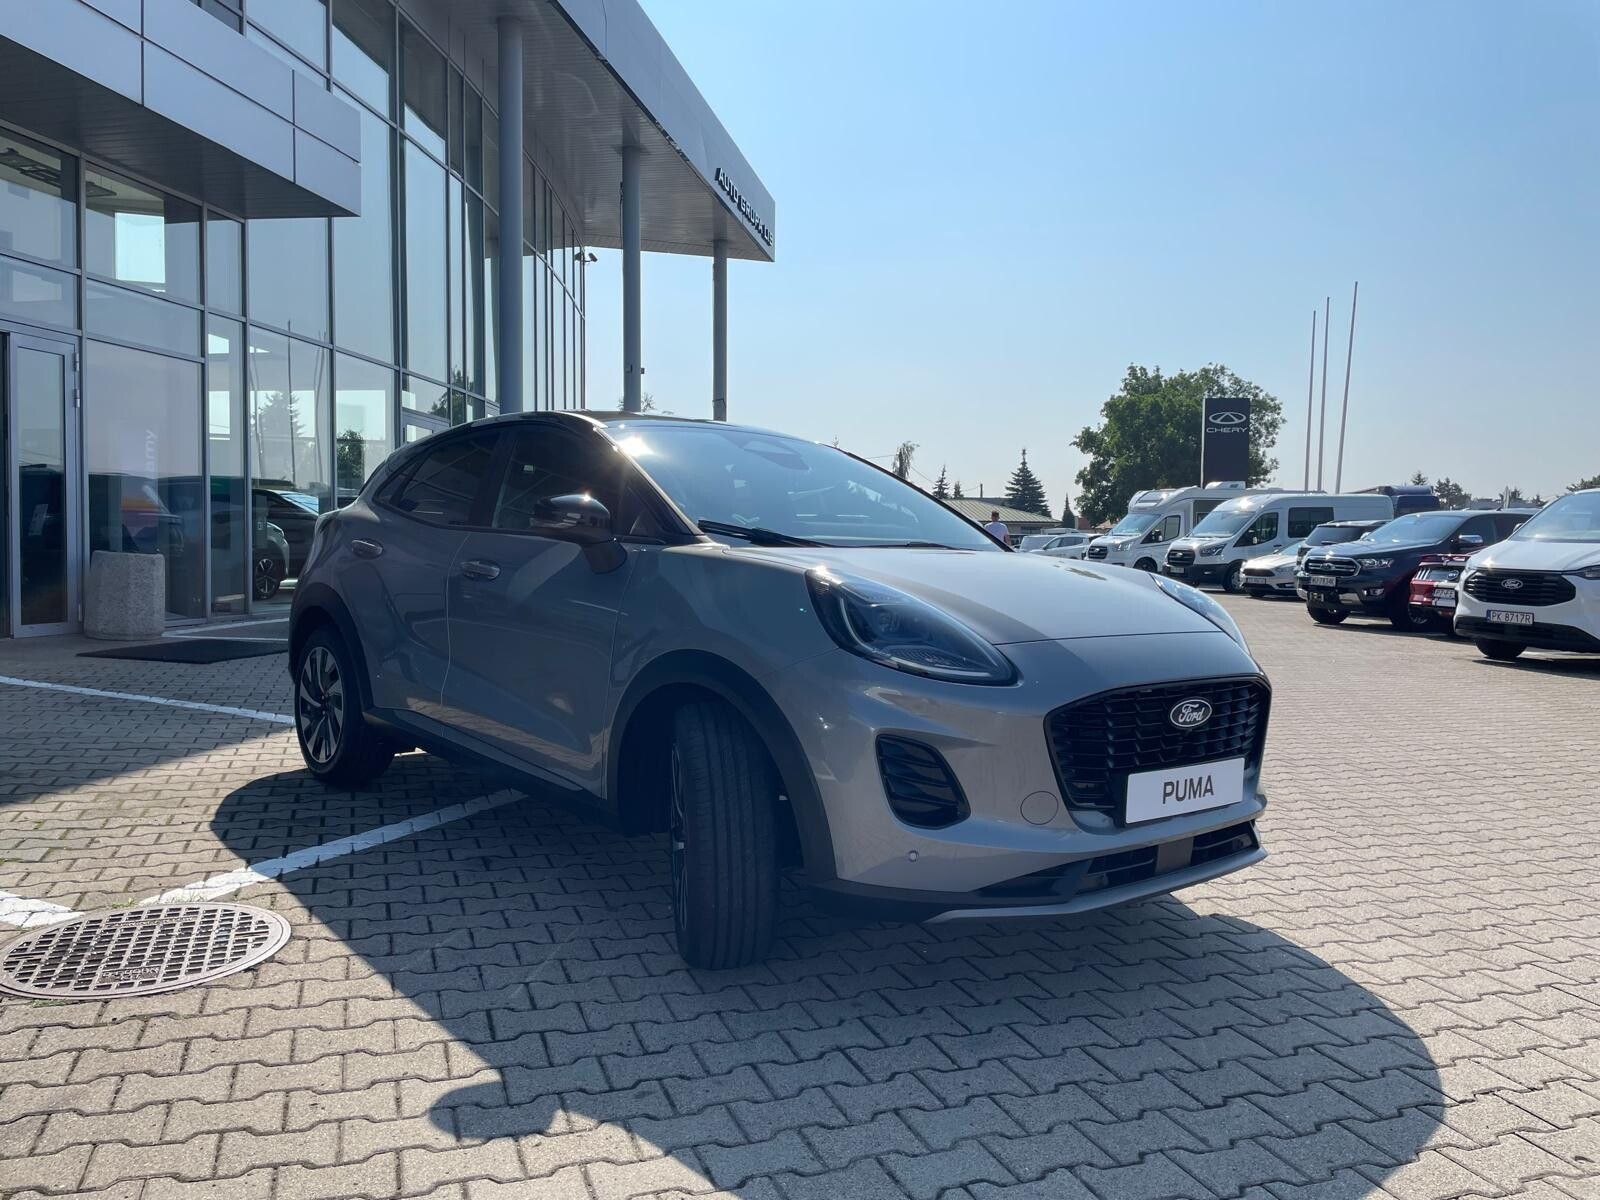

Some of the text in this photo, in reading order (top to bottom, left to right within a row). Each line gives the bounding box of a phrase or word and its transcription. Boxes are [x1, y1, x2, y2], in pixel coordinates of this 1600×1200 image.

[715, 167, 739, 203] AUTO
[1491, 611, 1531, 624] PK 8717R
[1178, 703, 1206, 723] Ford
[1162, 775, 1215, 804] PUMA
